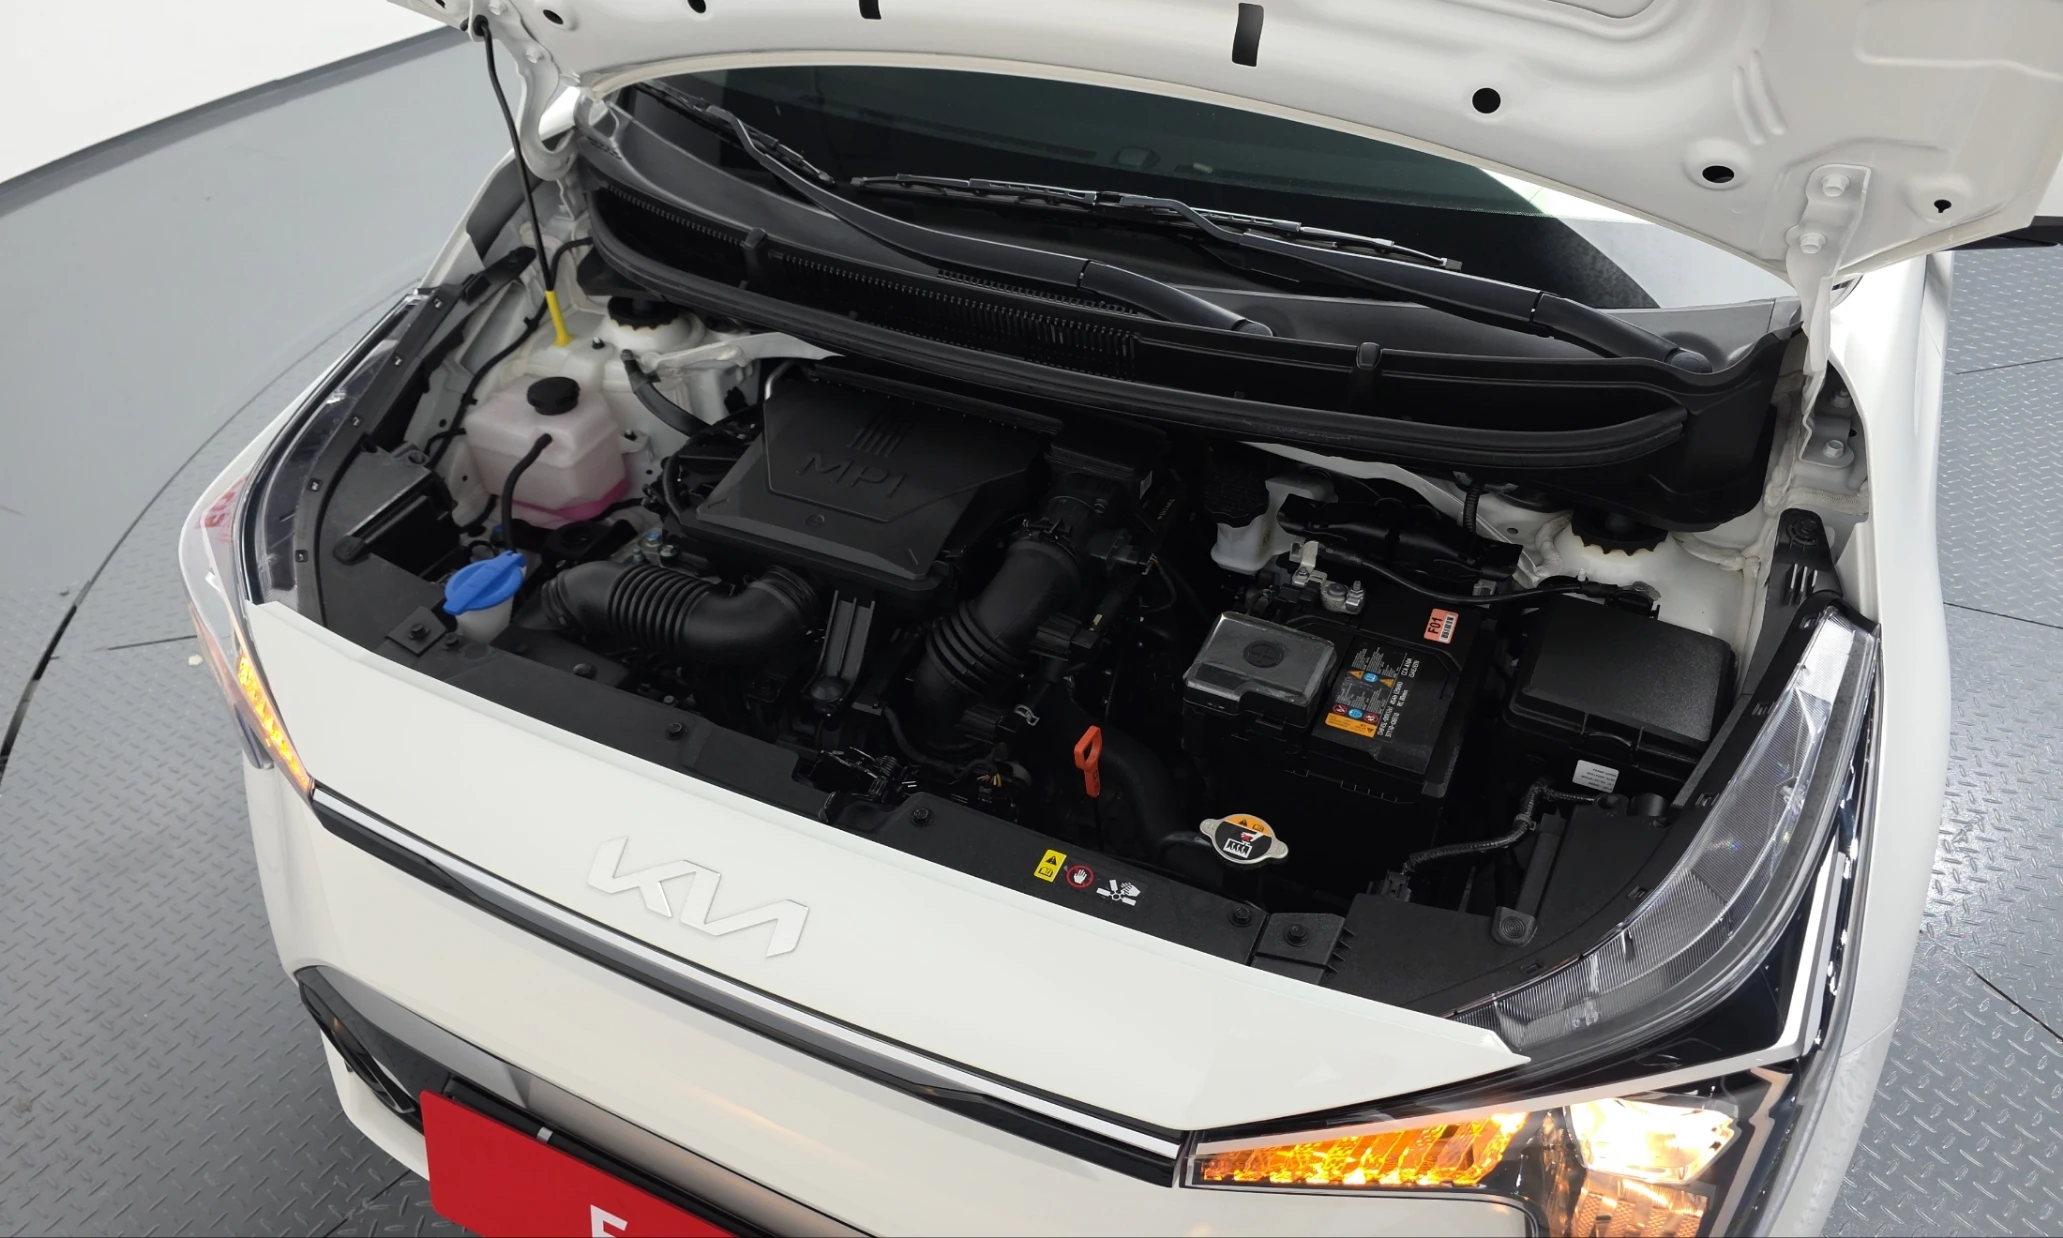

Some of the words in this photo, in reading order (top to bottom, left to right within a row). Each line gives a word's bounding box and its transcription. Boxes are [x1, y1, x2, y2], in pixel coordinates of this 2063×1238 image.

[796, 452, 908, 499] MPI
[1428, 617, 1443, 634] F01
[586, 836, 810, 958] KIA
